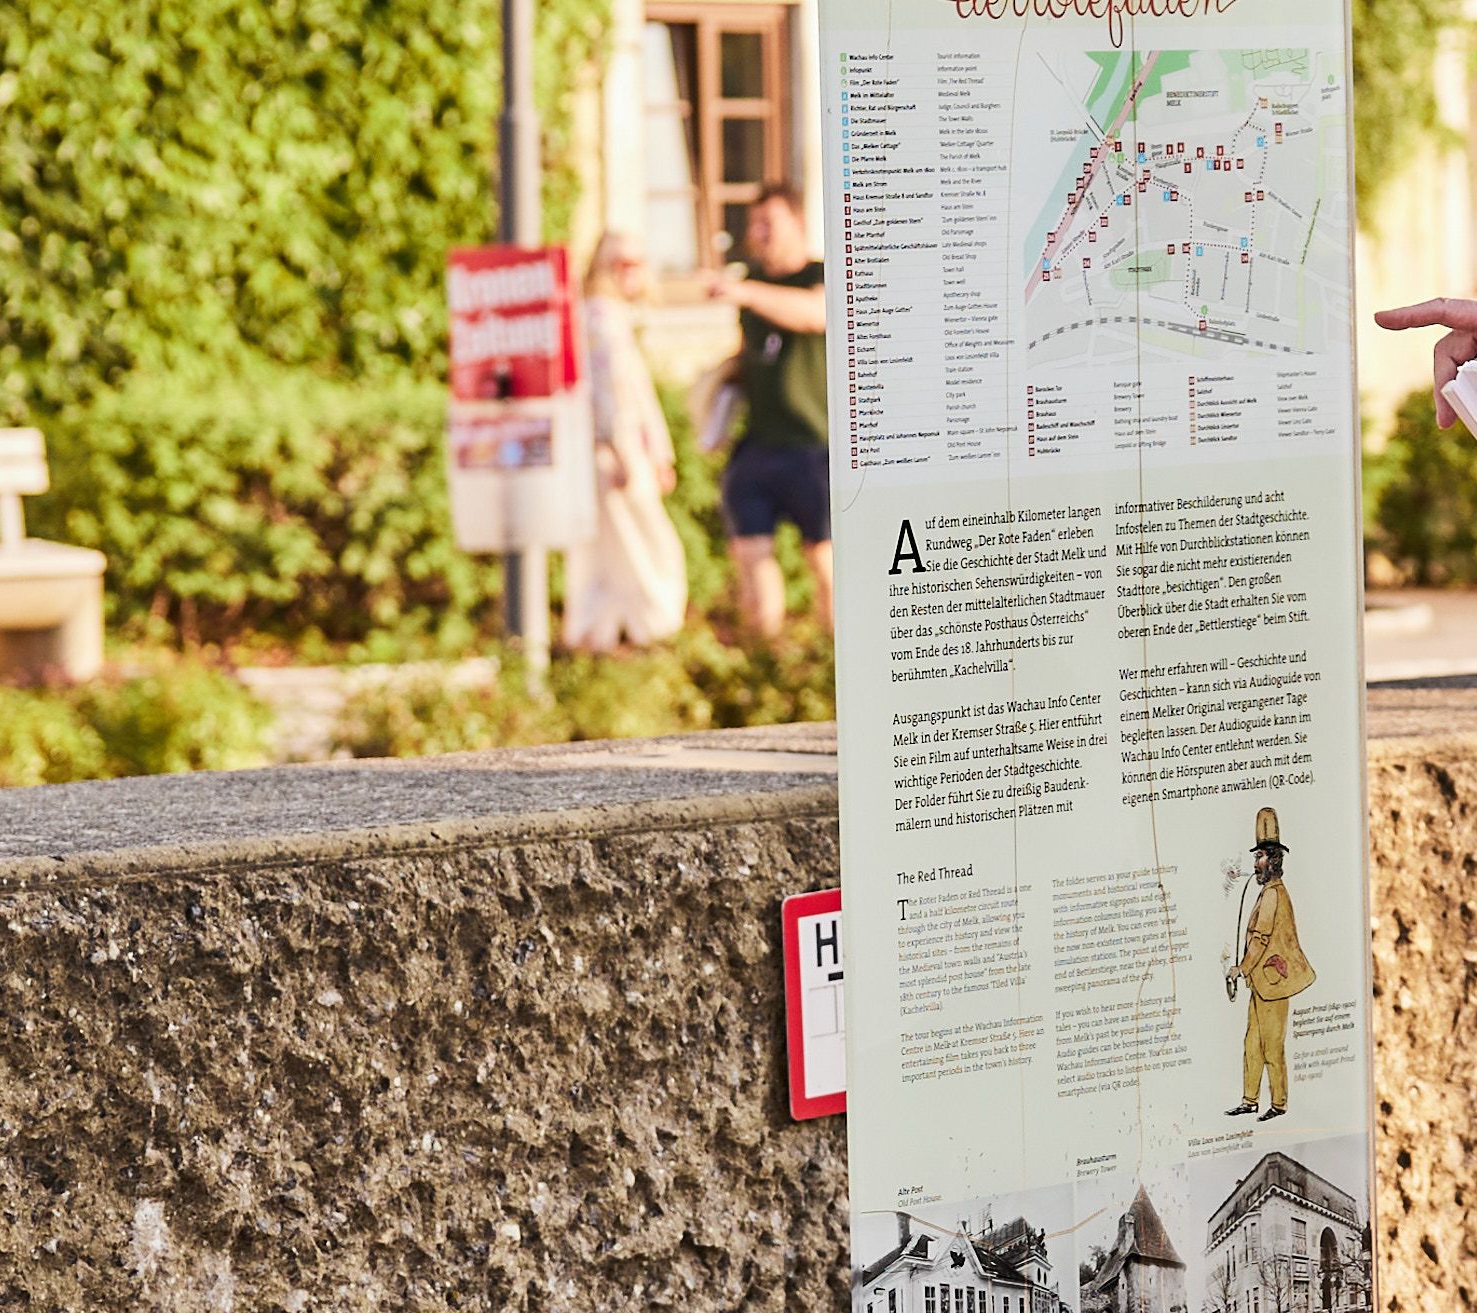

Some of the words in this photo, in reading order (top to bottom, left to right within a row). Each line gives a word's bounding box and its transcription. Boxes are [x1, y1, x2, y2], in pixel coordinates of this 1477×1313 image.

[1114, 499, 1174, 514] informativer
[1176, 495, 1242, 510] Beschilderung
[1244, 491, 1262, 504] und
[1264, 490, 1284, 502] acht
[937, 516, 960, 528] dem
[962, 511, 1015, 526] eineinhalb
[1017, 508, 1065, 522] Kilometer
[1067, 506, 1101, 521] langen
[1115, 520, 1163, 536] Infostelen
[1165, 522, 1176, 531] zu
[1177, 517, 1216, 530] Themen
[1218, 514, 1233, 527] der
[1235, 509, 1308, 527] Stadtgeschichte.
[925, 537, 972, 551] Rundweg
[997, 533, 1019, 544] Rote
[1057, 527, 1094, 539] erleben
[926, 560, 940, 572] Sie
[942, 558, 958, 570] die
[960, 554, 1014, 569] Geschichte
[1015, 552, 1032, 564] der
[1033, 549, 1059, 563] Stadt
[1061, 547, 1085, 560] Melk
[1087, 545, 1106, 558] und
[889, 584, 909, 596] ihre
[911, 579, 973, 594] historischen
[975, 571, 1074, 589] Sehenswürdigkeiten
[1084, 569, 1102, 579] von
[889, 605, 908, 618] den
[910, 603, 944, 616] Resten
[946, 600, 962, 612] der
[964, 593, 1047, 611] mittelalterlichen
[1049, 590, 1105, 603] Stadtmauer
[890, 626, 913, 639] über
[915, 624, 932, 637] das
[984, 616, 1028, 631] Posthaus
[890, 650, 913, 660] vom
[915, 644, 939, 658] Ende
[941, 643, 959, 656] des
[961, 641, 973, 654] 18.
[975, 636, 1040, 652] Jahrhunderts
[1041, 634, 1056, 646] bis
[1058, 634, 1073, 645] zur
[891, 667, 947, 682] berühmten
[892, 706, 971, 727] Ausgangspunkt
[973, 704, 985, 716] ist
[987, 703, 1004, 715] das
[1006, 699, 1045, 712] Wachau
[1047, 696, 1067, 708] Info
[1069, 693, 1100, 706] Center
[893, 732, 918, 746] Melk
[920, 733, 931, 743] in
[933, 729, 949, 742] der
[951, 727, 993, 740] Kremser
[995, 721, 1027, 735] Straße
[1029, 722, 1036, 734] 5.
[1038, 718, 1059, 730] Hier
[1061, 713, 1102, 728] entführt
[893, 755, 908, 768] Sie
[910, 755, 926, 766] ein
[928, 751, 951, 763] Film
[953, 747, 970, 761] auf
[971, 742, 1043, 759] unterhaltsame
[1045, 738, 1074, 750] Weise
[1076, 738, 1086, 747] in
[1088, 734, 1107, 746] drei
[894, 774, 937, 789] wichtige
[939, 768, 983, 784] Perioden
[985, 766, 1001, 779] der
[1003, 757, 1082, 777] Stadtgeschichte.
[894, 798, 912, 810] Der
[914, 794, 946, 808] Folder
[947, 790, 973, 804] führt
[975, 789, 990, 801] Sie
[992, 789, 1003, 799] zu
[1005, 783, 1041, 797] dreißig
[1043, 777, 1089, 793] Baudenk-
[1122, 789, 1160, 806] eigenen
[1161, 784, 1219, 800] Smartphone
[1221, 777, 1266, 793] anwählen
[895, 817, 931, 831] mälern
[933, 813, 953, 827] und
[955, 807, 1016, 824] historischen
[1018, 804, 1054, 817] Plätzen
[1056, 800, 1072, 812] mit
[896, 872, 915, 884] The
[917, 868, 936, 882] Red
[937, 864, 973, 879] Thread
